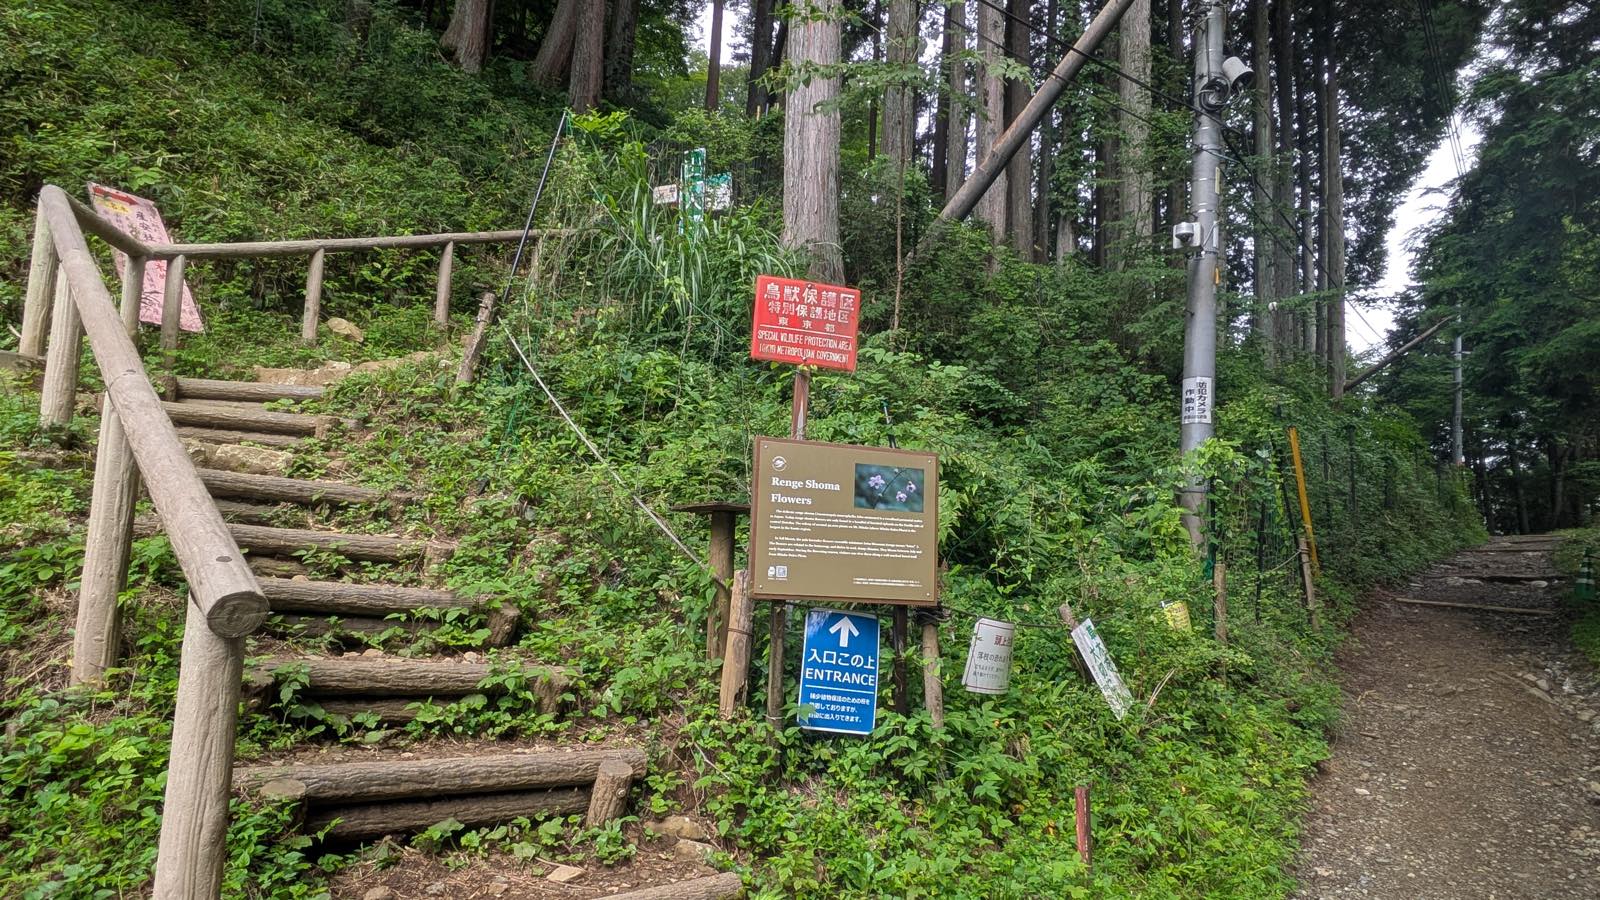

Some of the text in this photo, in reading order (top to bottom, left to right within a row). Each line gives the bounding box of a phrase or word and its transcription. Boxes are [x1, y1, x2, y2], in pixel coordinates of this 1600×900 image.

[764, 282, 855, 311] 鳥獣保護区
[767, 300, 850, 324] 特別保護地区
[757, 329, 853, 351] SPECIAL WILDLIFE PROTECTION AREA
[816, 350, 849, 364] GOVERNMENT
[1185, 388, 1195, 413] 作動中
[1196, 381, 1208, 415] 防犯カメラ
[772, 476, 841, 491] Renge Shoma
[771, 493, 812, 505] Flowers
[807, 648, 875, 669] 入口この上
[805, 668, 875, 686] ENTRANCE
